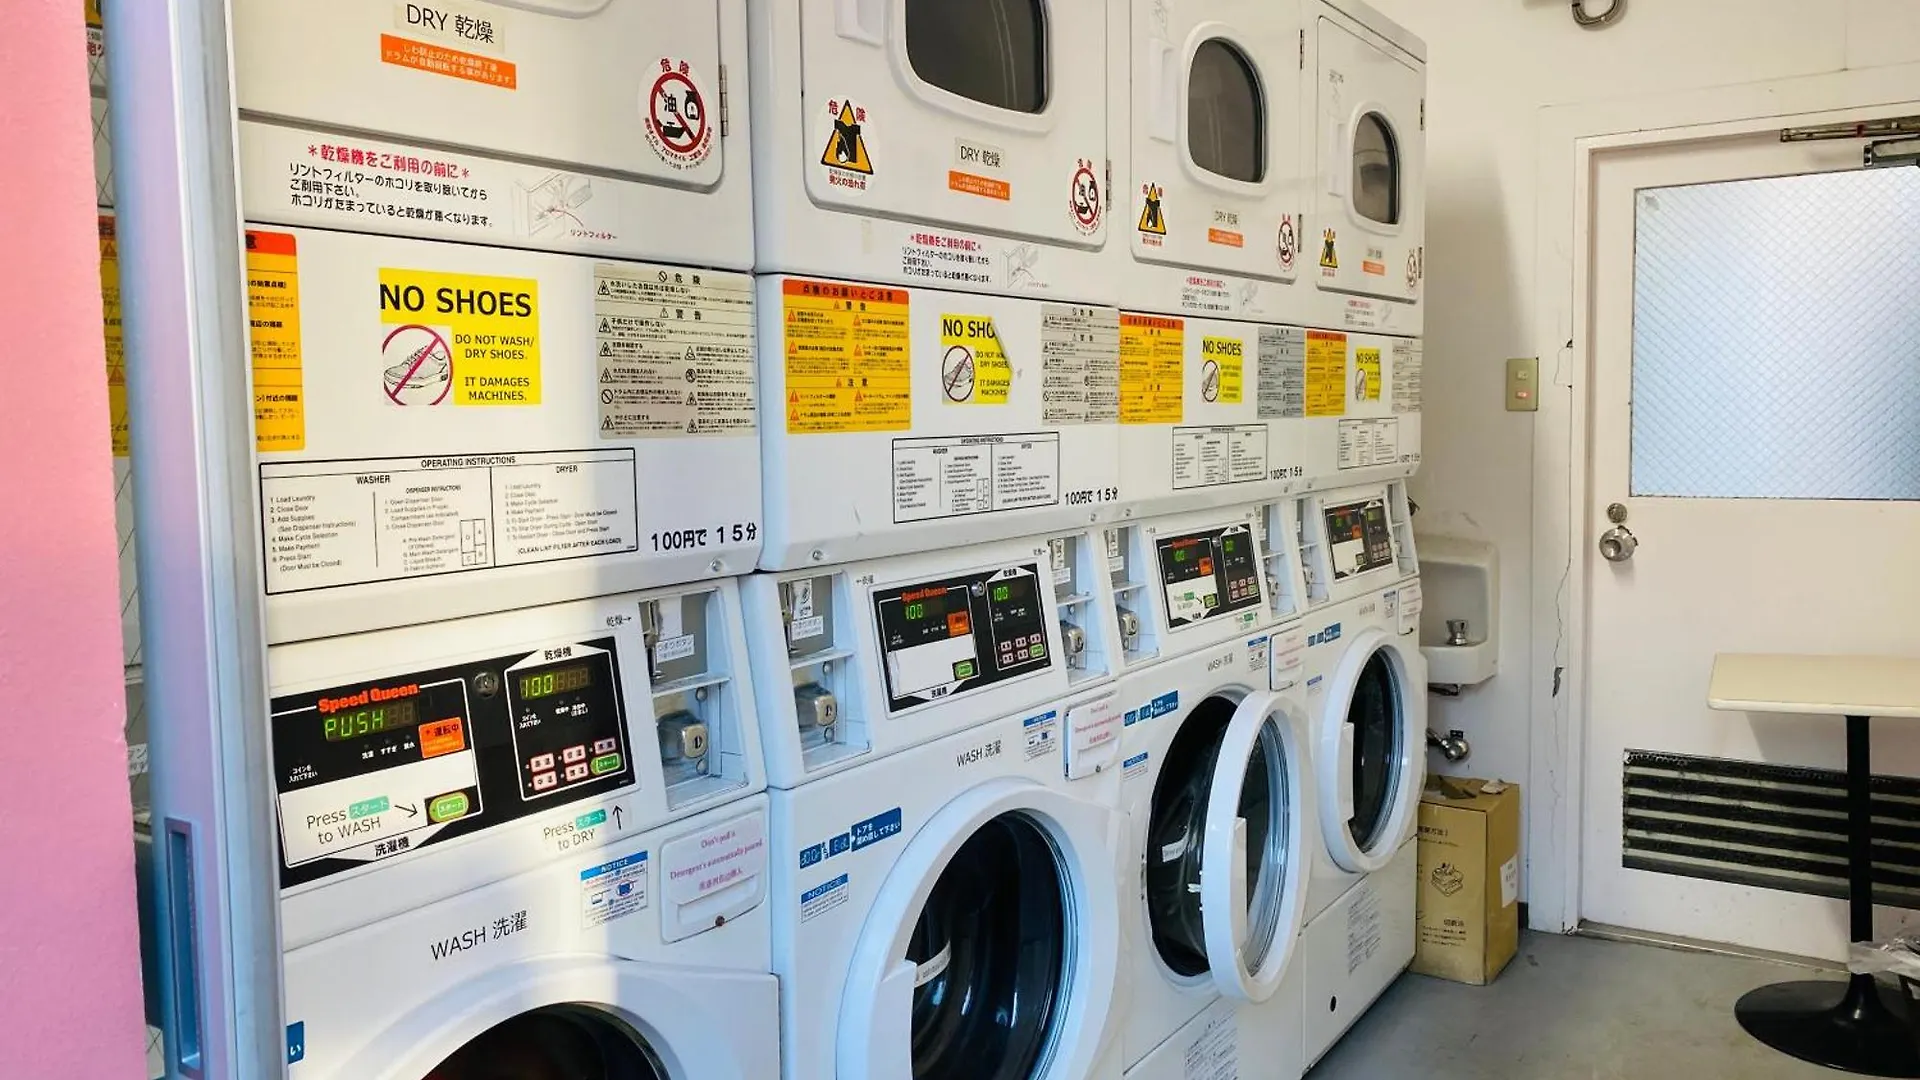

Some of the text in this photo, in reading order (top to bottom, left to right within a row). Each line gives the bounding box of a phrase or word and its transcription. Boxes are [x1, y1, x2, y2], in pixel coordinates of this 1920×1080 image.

[406, 3, 494, 43] DRY 乾燥
[664, 94, 677, 112] 油
[960, 145, 1001, 168] DRY 乾燥
[381, 283, 532, 317] NO SHOES
[943, 319, 964, 337] NO
[455, 334, 534, 347] DO NOT WASH/
[1202, 339, 1242, 357] NO SHOES
[464, 348, 528, 361] DRY SHOES.
[464, 376, 531, 388] IT DAMAGES
[467, 390, 528, 402] MACHINES.
[421, 455, 516, 469] OPERATING INSTRUCTIONS
[556, 464, 579, 474] DRYER
[356, 475, 391, 485] WASHER
[292, 494, 317, 504] Laundry
[277, 504, 310, 513] Close Door
[291, 513, 316, 523] Supplies
[293, 521, 321, 532] Dispenser
[278, 531, 339, 543] Make Cycle Selection
[650, 528, 708, 552] 100円で
[279, 542, 321, 553] Make Payment
[279, 554, 297, 563] Press
[993, 585, 1009, 603] 100
[905, 602, 923, 620] 100
[545, 646, 572, 661] 乾燥機
[523, 673, 553, 698] 100
[318, 683, 421, 713] Speed Queen
[325, 709, 386, 739] PUSH
[957, 746, 983, 768] WASH
[306, 801, 389, 830] Press スタート
[318, 817, 382, 845] to WASH
[543, 824, 575, 844] Press
[375, 836, 411, 858] 洗濯機
[558, 830, 596, 855] to DRY
[601, 858, 630, 873] NOTICE
[808, 878, 843, 899] NOTICE
[431, 910, 528, 961] WASH 洗濯
